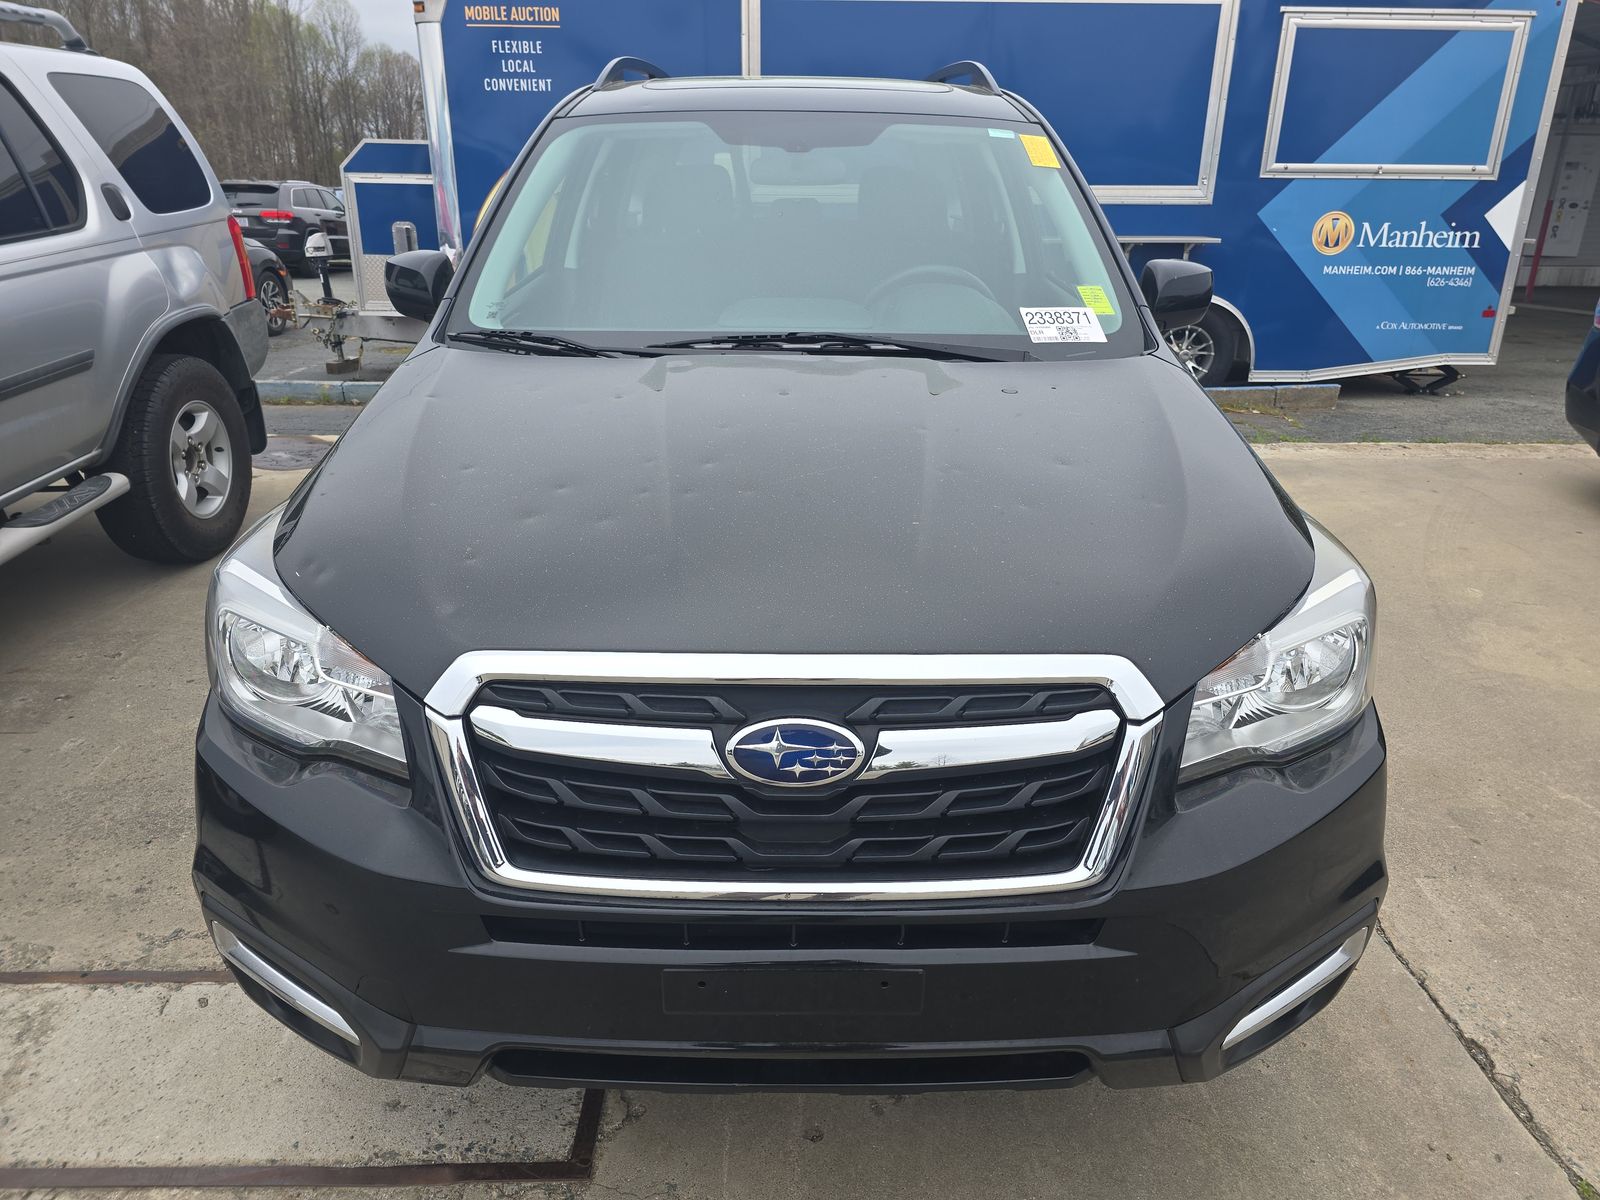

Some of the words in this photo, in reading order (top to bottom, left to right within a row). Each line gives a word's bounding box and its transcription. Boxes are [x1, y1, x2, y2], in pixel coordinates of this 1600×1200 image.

[464, 6, 508, 20] MOBILE
[511, 7, 560, 22] AUCTION
[491, 40, 543, 54] FLEXIBLE
[502, 59, 536, 73] LOCAL
[484, 78, 552, 92] CONVENIENT
[1356, 221, 1481, 249] Manheim
[1323, 265, 1398, 275] MANHEIM.COM
[1405, 266, 1476, 276] 866-MANHEIM
[1427, 277, 1473, 288] (626-4346)
[1025, 311, 1092, 325] 2338371
